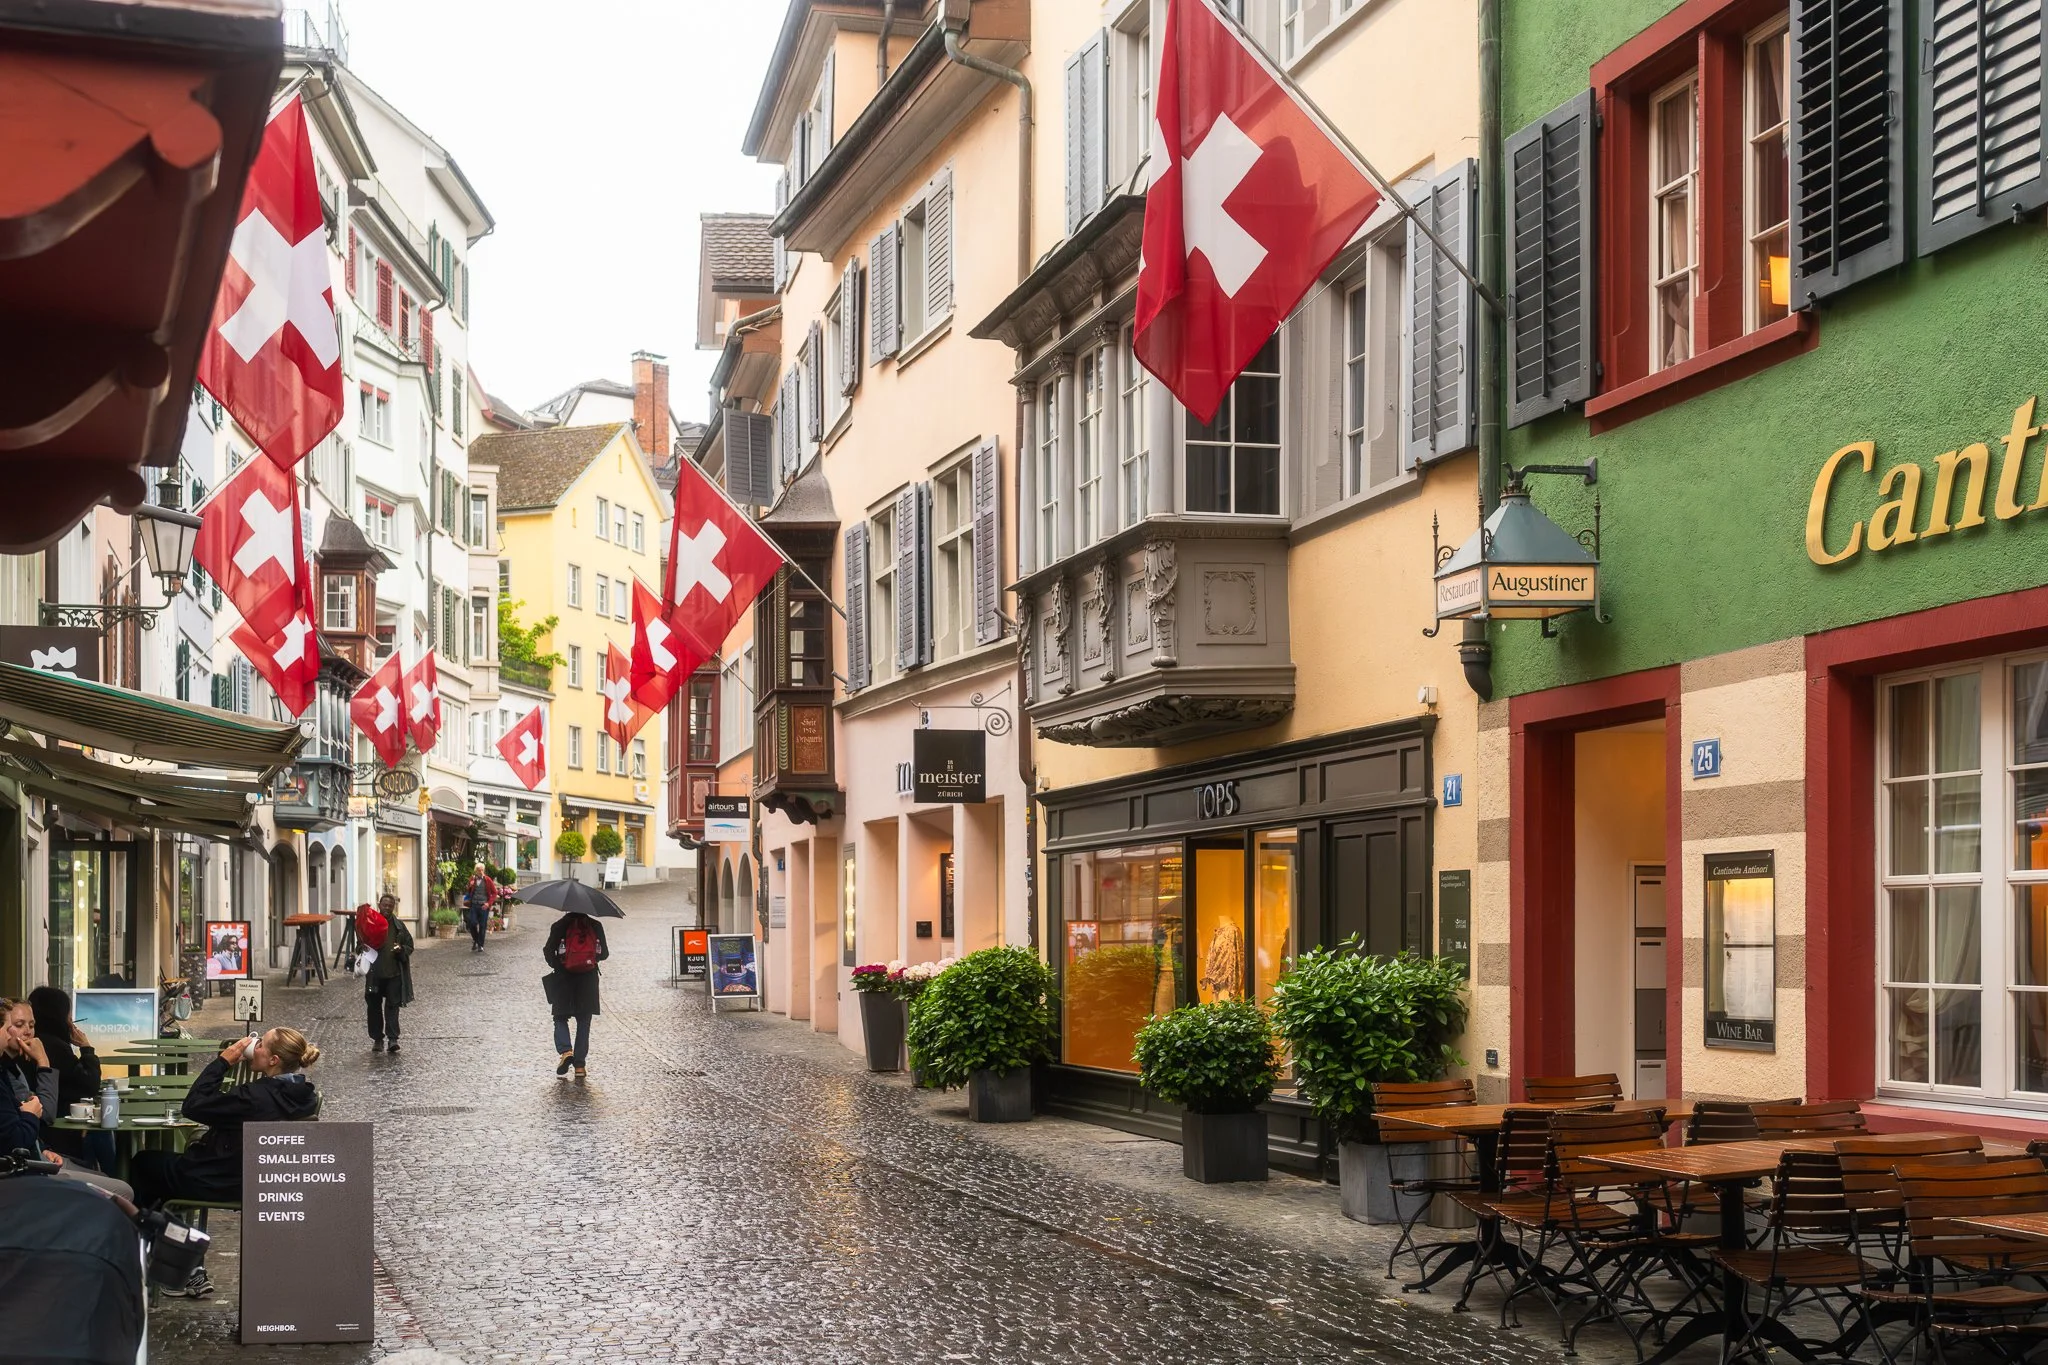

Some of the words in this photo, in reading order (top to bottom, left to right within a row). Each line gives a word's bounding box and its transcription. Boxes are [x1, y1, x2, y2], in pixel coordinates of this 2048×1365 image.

[1439, 578, 1480, 602] Restaurant
[1492, 572, 1588, 597] Augustiner
[1697, 745, 1713, 772] 25
[384, 772, 414, 793] ROECKL
[919, 771, 982, 784] meister
[937, 790, 963, 798] ZÜRICH
[1446, 779, 1456, 801] 21
[1193, 780, 1237, 820] TOPS
[708, 803, 735, 811] airtours
[1713, 866, 1742, 876] Cantinetta
[1743, 864, 1769, 874] Antinori
[210, 924, 244, 936] SALE
[90, 1023, 139, 1033] HORIZON
[258, 1135, 305, 1145] COFFEE
[258, 1154, 300, 1164] SMALL
[301, 1154, 336, 1164] BITES
[258, 1173, 300, 1183] LUNCH
[303, 1173, 346, 1183] BOWLS
[258, 1192, 304, 1202] DRINKS
[258, 1211, 305, 1222] EVENTS
